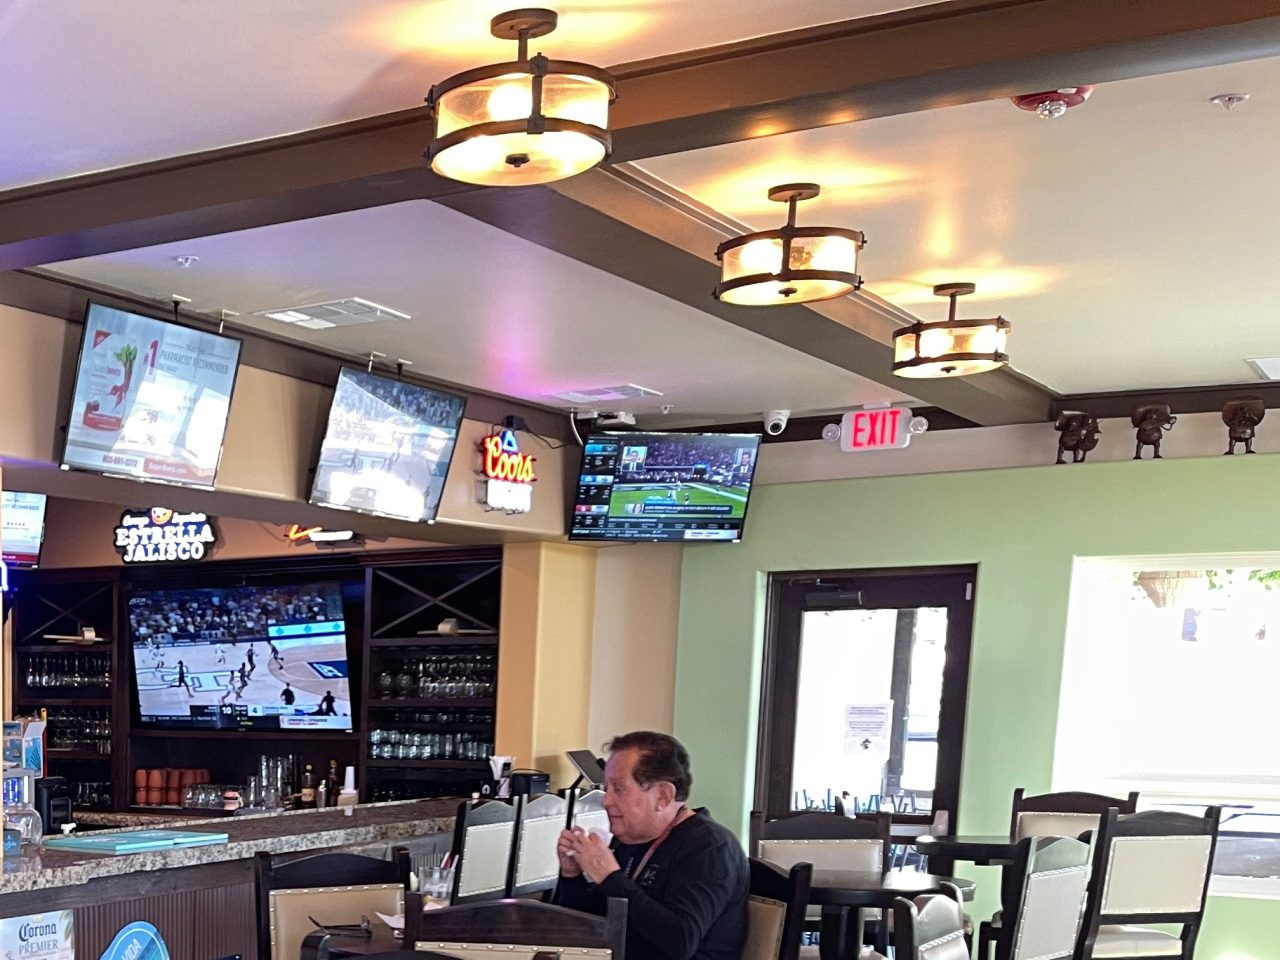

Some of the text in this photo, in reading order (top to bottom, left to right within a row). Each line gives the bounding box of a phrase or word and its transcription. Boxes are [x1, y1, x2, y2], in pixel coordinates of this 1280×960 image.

[852, 410, 901, 448] EXIT
[484, 436, 535, 482] Coors
[115, 524, 215, 546] ESTRELLA
[123, 541, 204, 562] JALISCO
[220, 706, 233, 715] 10
[18, 923, 56, 944] Corona
[19, 938, 59, 954] PREMIER
